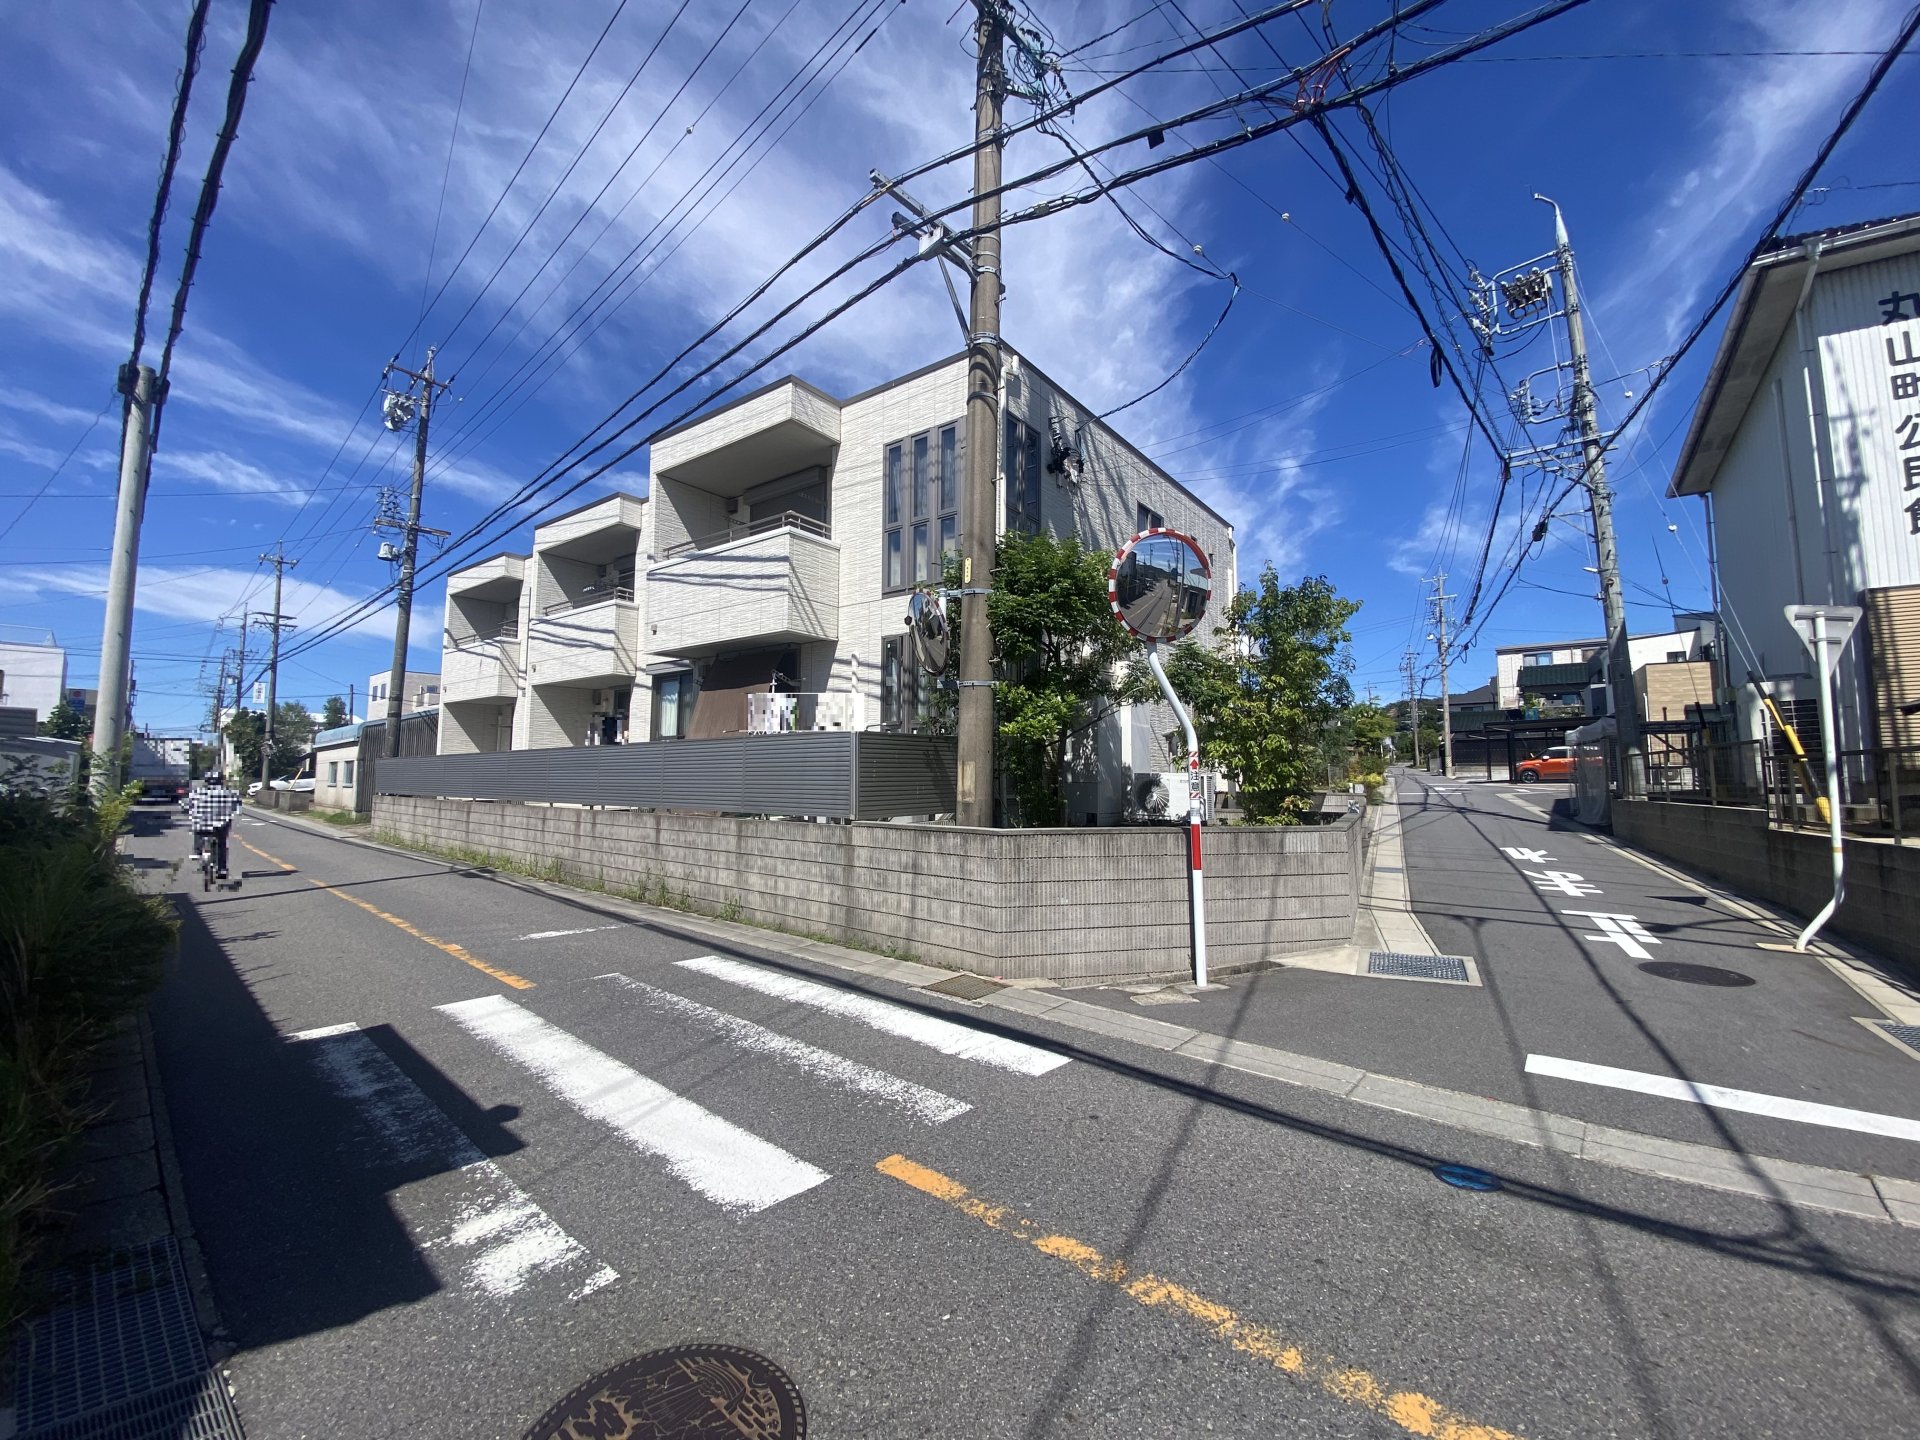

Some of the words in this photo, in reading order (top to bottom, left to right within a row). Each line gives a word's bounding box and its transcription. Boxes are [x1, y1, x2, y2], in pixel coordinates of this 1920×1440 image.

[1190, 771, 1200, 791] 注意
[1500, 847, 1662, 959] 止まれ
